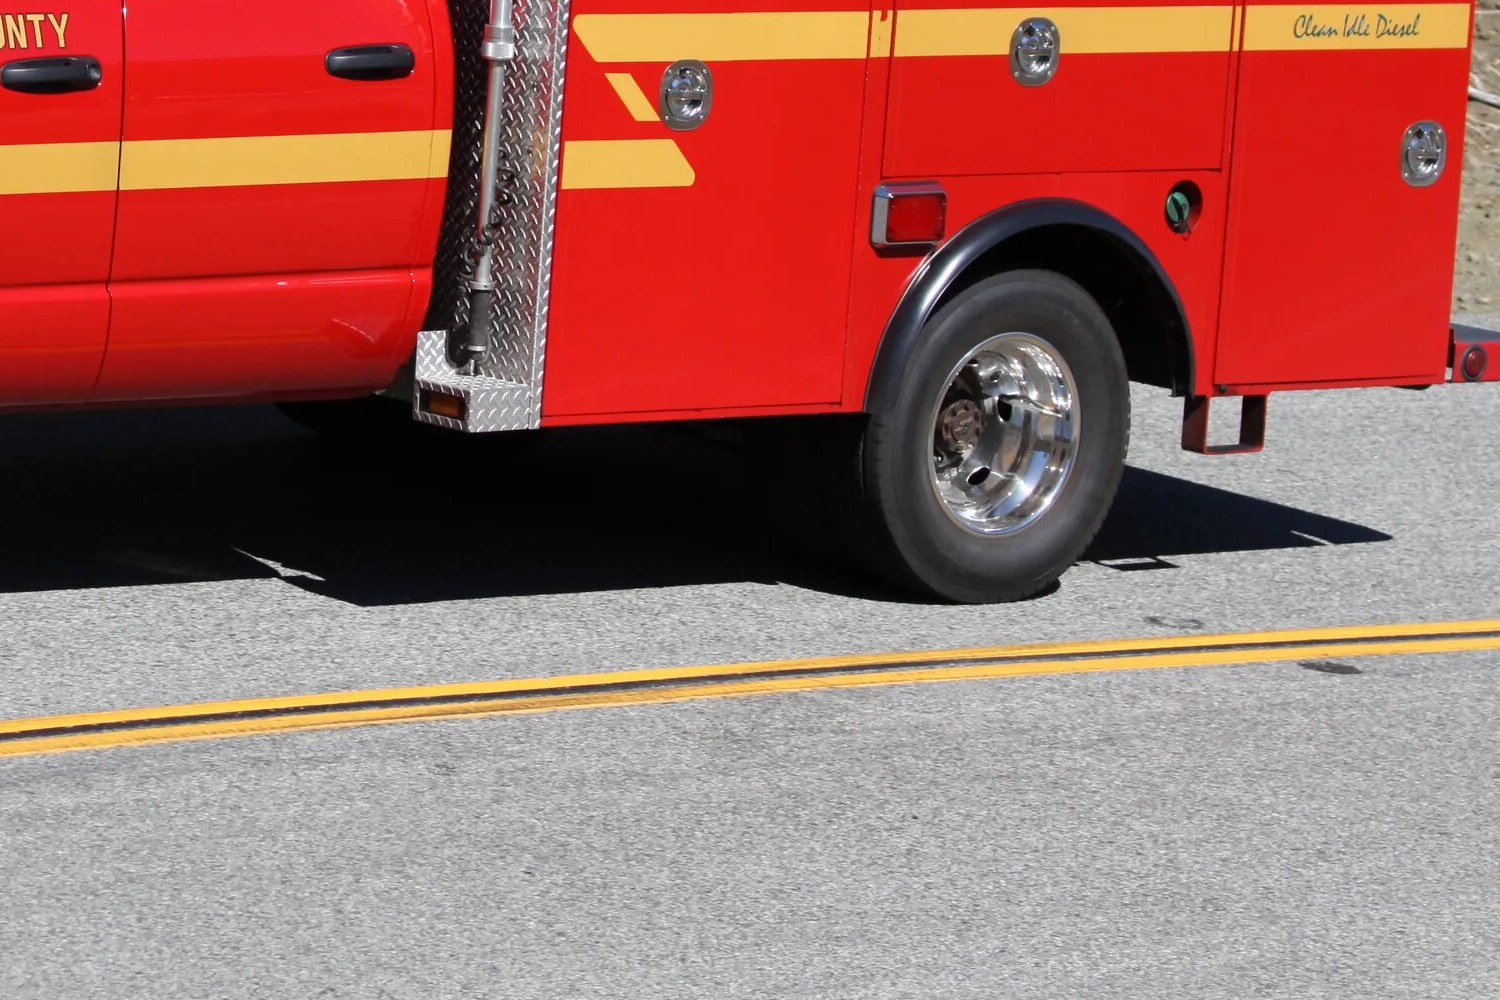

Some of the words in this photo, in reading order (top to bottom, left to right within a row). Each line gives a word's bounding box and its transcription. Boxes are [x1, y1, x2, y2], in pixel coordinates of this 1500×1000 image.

[1293, 14, 1338, 39] Clean
[1343, 14, 1370, 38] Idle
[1375, 13, 1421, 39] Diesel
